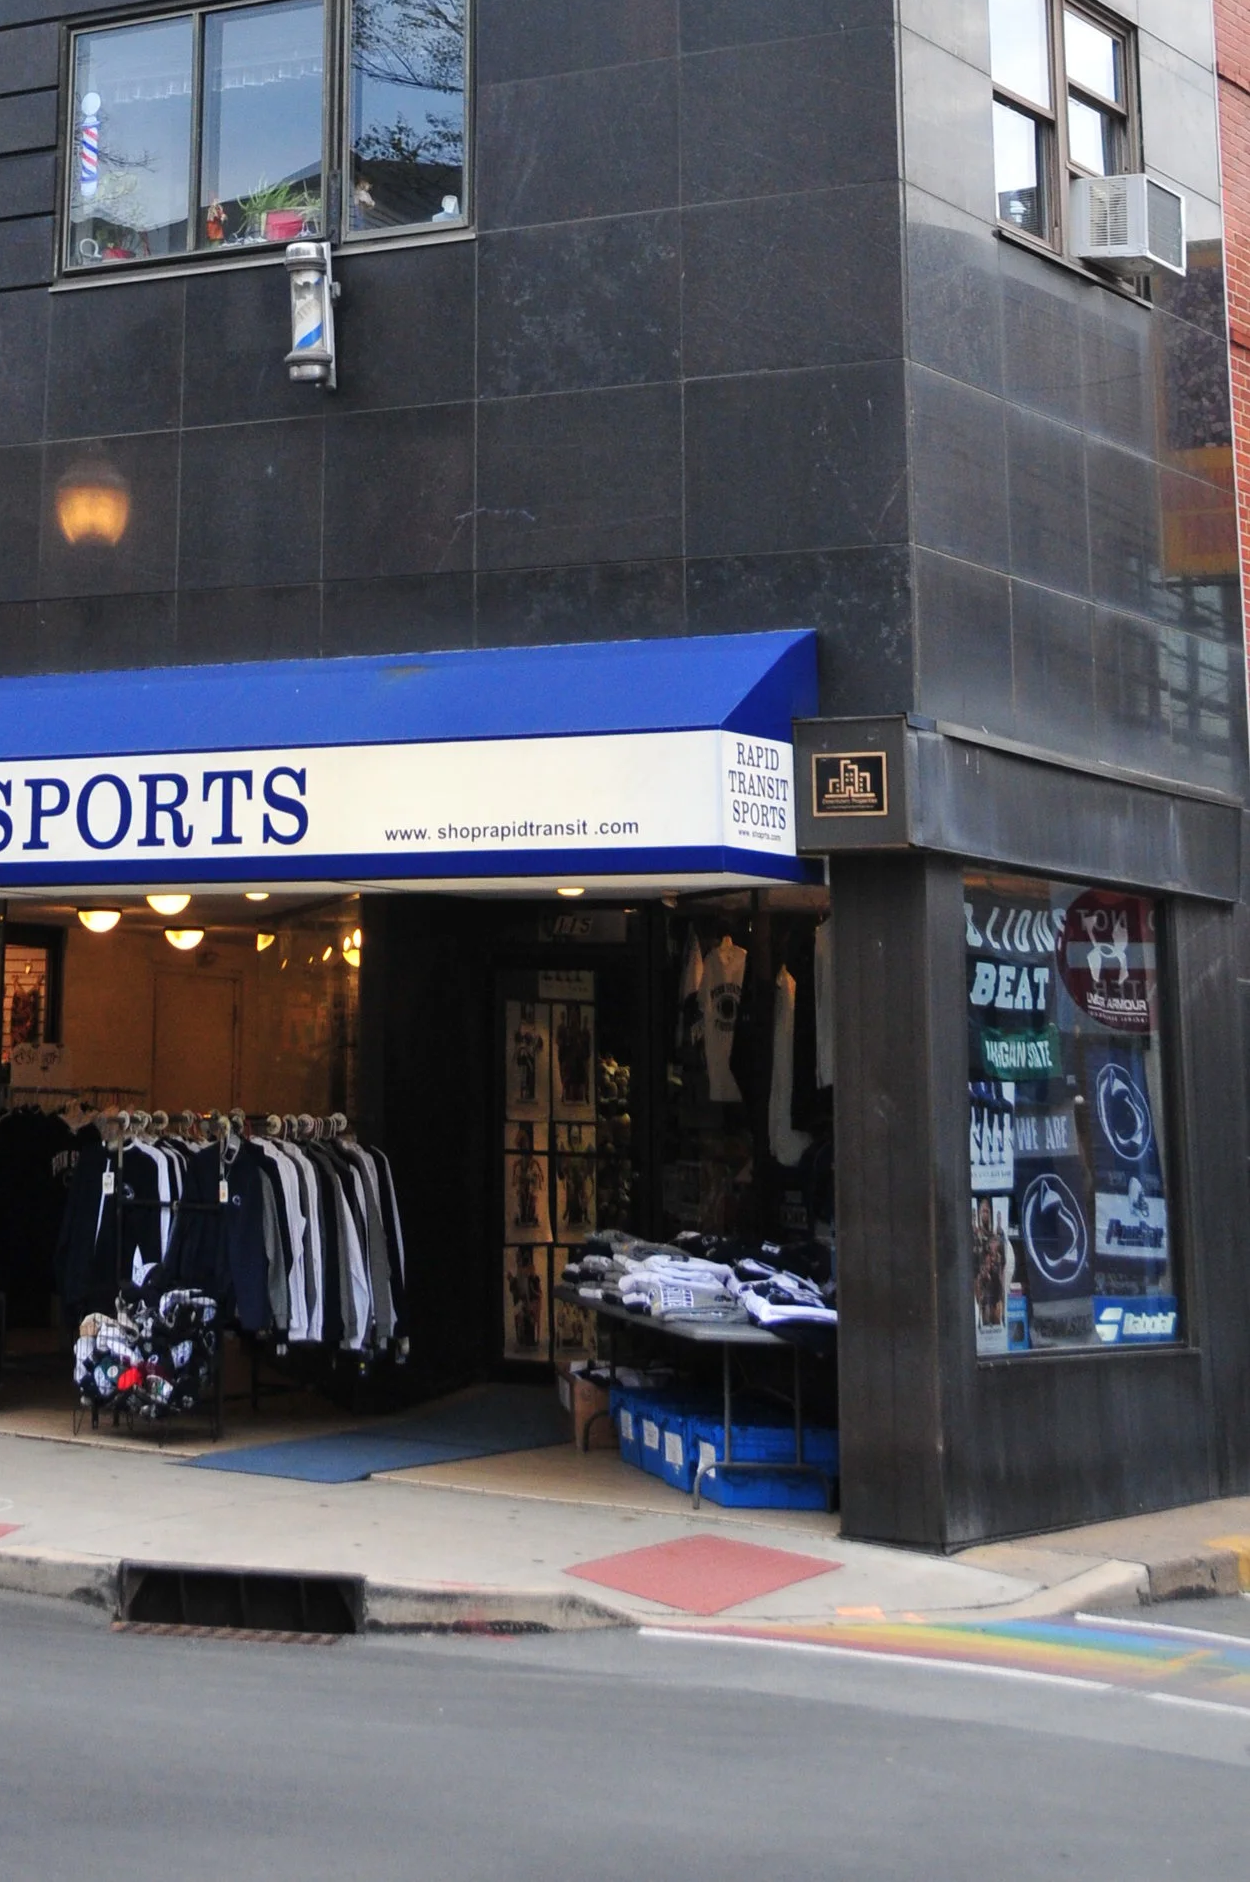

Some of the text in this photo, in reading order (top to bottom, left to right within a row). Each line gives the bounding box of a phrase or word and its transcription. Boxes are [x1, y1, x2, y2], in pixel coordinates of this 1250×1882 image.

[736, 742, 780, 771] RAPID
[728, 770, 789, 802] TRANSIT
[732, 799, 787, 830] SPORTS
[437, 819, 587, 842] shoprapidtransit
[969, 961, 1049, 1010] BEAT
[1107, 997, 1147, 1011] ARMOUR
